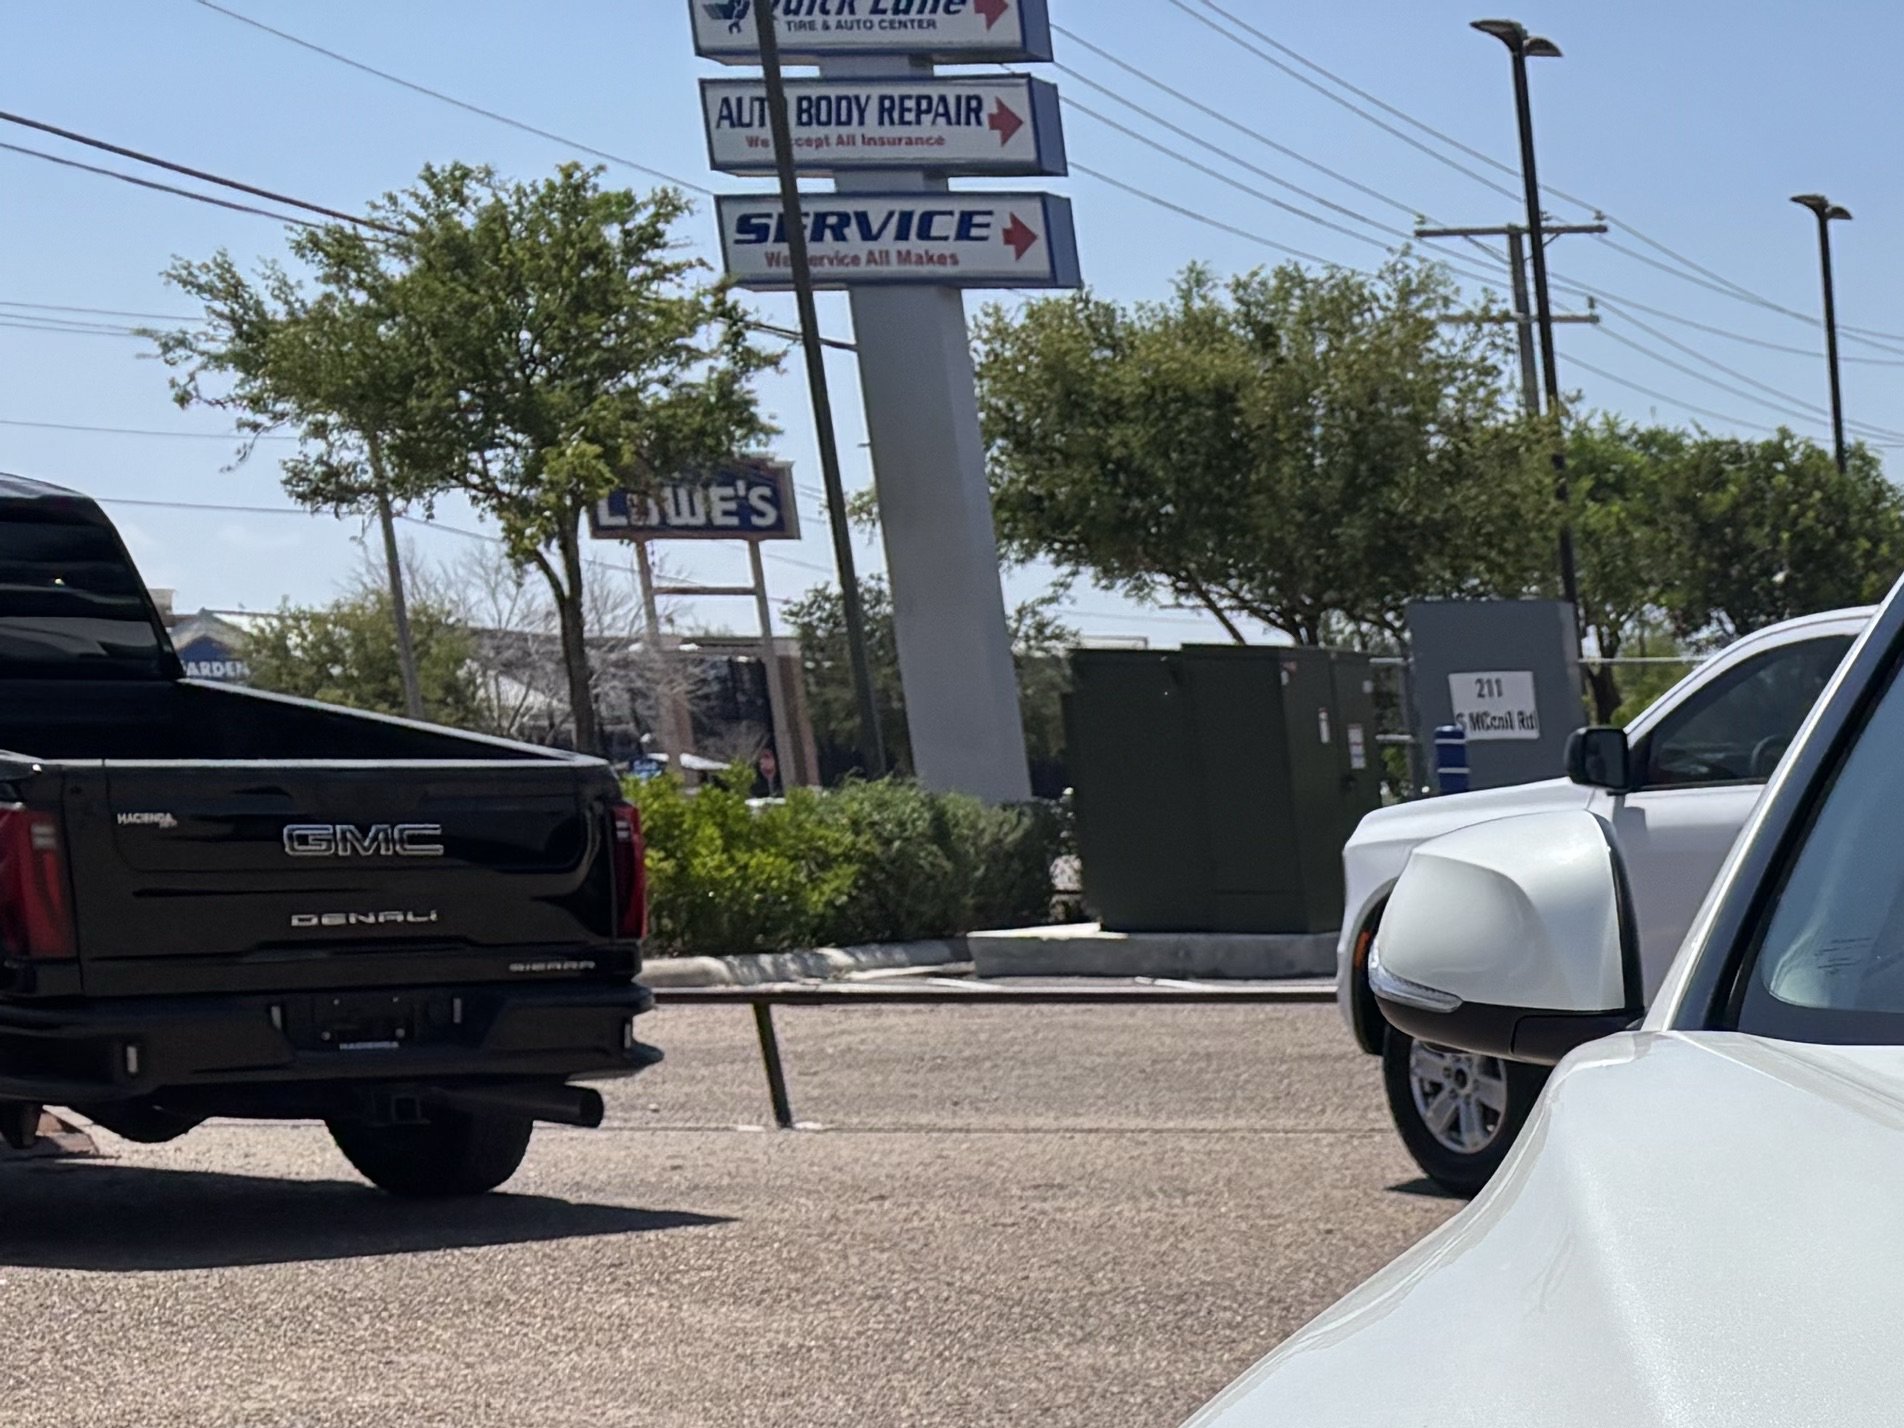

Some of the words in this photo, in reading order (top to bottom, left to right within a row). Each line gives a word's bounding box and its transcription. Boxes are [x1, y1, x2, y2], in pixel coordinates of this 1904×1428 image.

[786, 20, 818, 31] TIRE
[821, 20, 831, 31] &
[834, 19, 884, 31] AUTO
[886, 18, 938, 31] CENTER
[715, 96, 786, 129] AUT
[795, 95, 871, 128] BODY
[876, 94, 985, 128] REPAIR
[744, 135, 771, 149] We
[786, 134, 832, 151] ccept
[835, 133, 858, 148] All
[861, 132, 946, 148] Insurance
[764, 251, 790, 268] We
[800, 250, 862, 268] ervice
[864, 249, 891, 267] All
[896, 248, 961, 267] Makes
[1474, 677, 1504, 699] 211
[282, 823, 445, 857] GMC
[290, 908, 439, 927] DENALI
